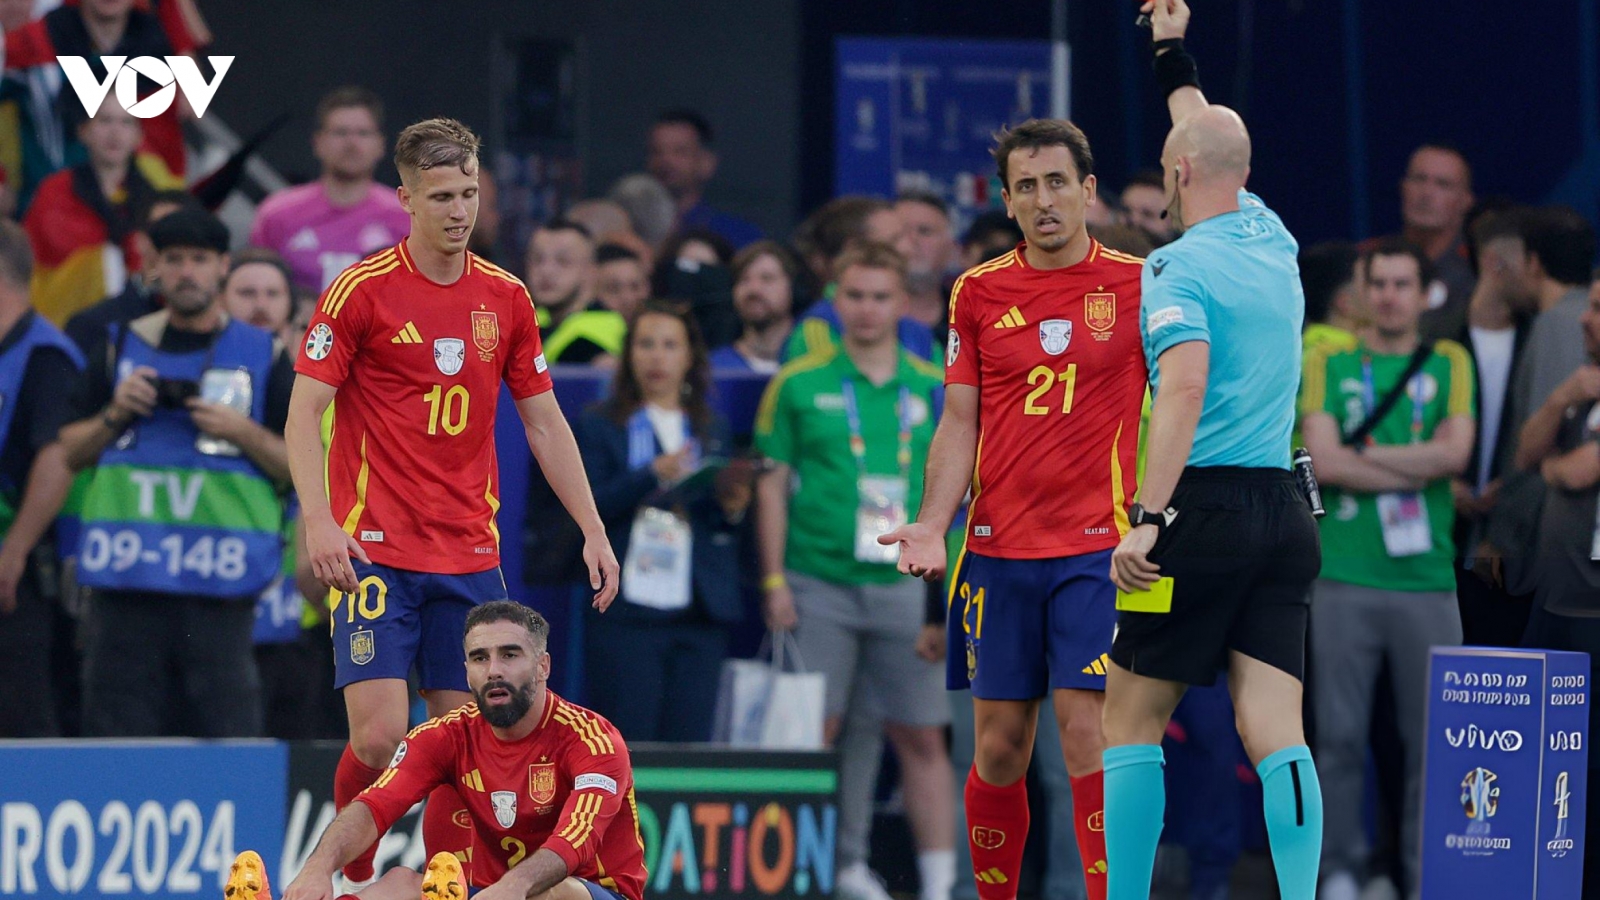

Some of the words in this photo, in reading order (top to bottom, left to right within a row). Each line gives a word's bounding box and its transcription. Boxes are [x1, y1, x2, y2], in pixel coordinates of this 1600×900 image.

[423, 384, 470, 436] 10
[1023, 363, 1077, 415] 21
[128, 469, 205, 520] TV
[82, 528, 247, 580] 09-148
[959, 581, 985, 639] 21
[500, 836, 527, 869] 2
